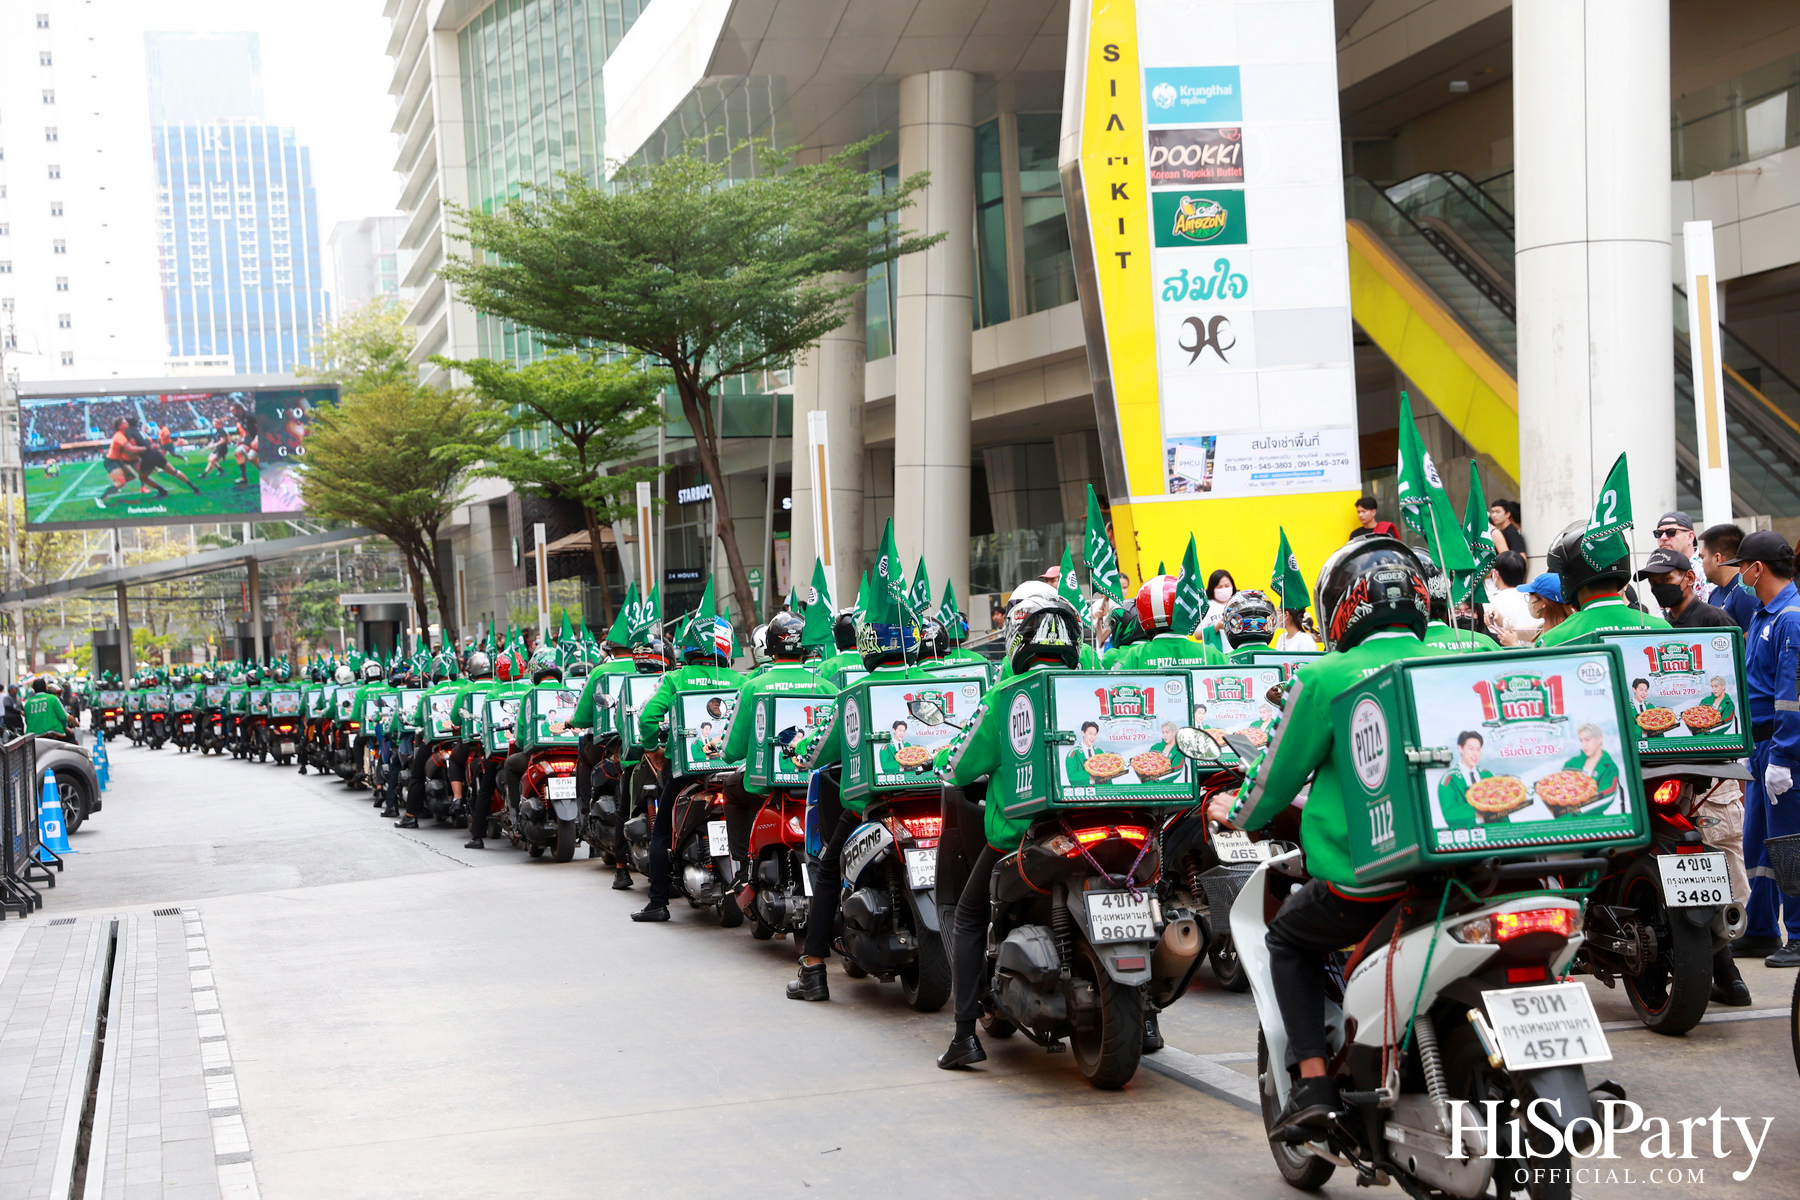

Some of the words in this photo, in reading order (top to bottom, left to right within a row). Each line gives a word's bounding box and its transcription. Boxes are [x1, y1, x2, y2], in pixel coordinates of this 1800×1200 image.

[1180, 85, 1232, 98] Krungthai
[1151, 143, 1240, 167] DOOKKI
[1151, 170, 1179, 179] Korean
[1182, 168, 1215, 180] Topokki
[1217, 167, 1242, 177] Buffet
[1162, 258, 1248, 302] สมใจ
[1251, 432, 1320, 449] สนใจเช่าพื้นที่
[1179, 460, 1200, 468] PMCU
[1379, 572, 1403, 581] INDEX
[1157, 657, 1177, 667] PIZZA
[1663, 660, 1691, 672] แถม
[1581, 667, 1602, 678] PIZZA
[695, 677, 712, 686] PIZZA
[775, 682, 794, 691] PIZZA
[1219, 690, 1241, 699] แถม
[1472, 679, 1499, 721] 1
[1502, 701, 1545, 719] แถม
[1543, 675, 1565, 716] 1
[1683, 688, 1701, 696] 279.-
[30, 702, 48, 714] 1112
[1095, 687, 1110, 716] 1
[1114, 703, 1141, 715] แถม
[1142, 687, 1155, 715] 1
[1012, 709, 1032, 739] PIZZA
[1133, 733, 1151, 741] 279.-
[1355, 721, 1384, 767] PIZZA
[1500, 744, 1532, 758] เริ่มต้น
[1535, 744, 1563, 755] 279.-
[849, 756, 861, 780] 1112
[1015, 764, 1033, 794] 1112
[1369, 800, 1395, 846] 1112
[846, 828, 881, 869] RACING
[1230, 849, 1258, 860] 465
[1676, 858, 1712, 872] 4ขญ
[1667, 876, 1727, 887] กรุงเทพมหานคร
[1677, 889, 1722, 903] 3480
[1092, 911, 1152, 925] กรุงเทพมหานคร
[1101, 924, 1147, 940] 9607
[1511, 995, 1567, 1016] 5ขท
[1502, 1018, 1591, 1039] กรุงเทพมหานคร
[1524, 1036, 1588, 1060] 4571
